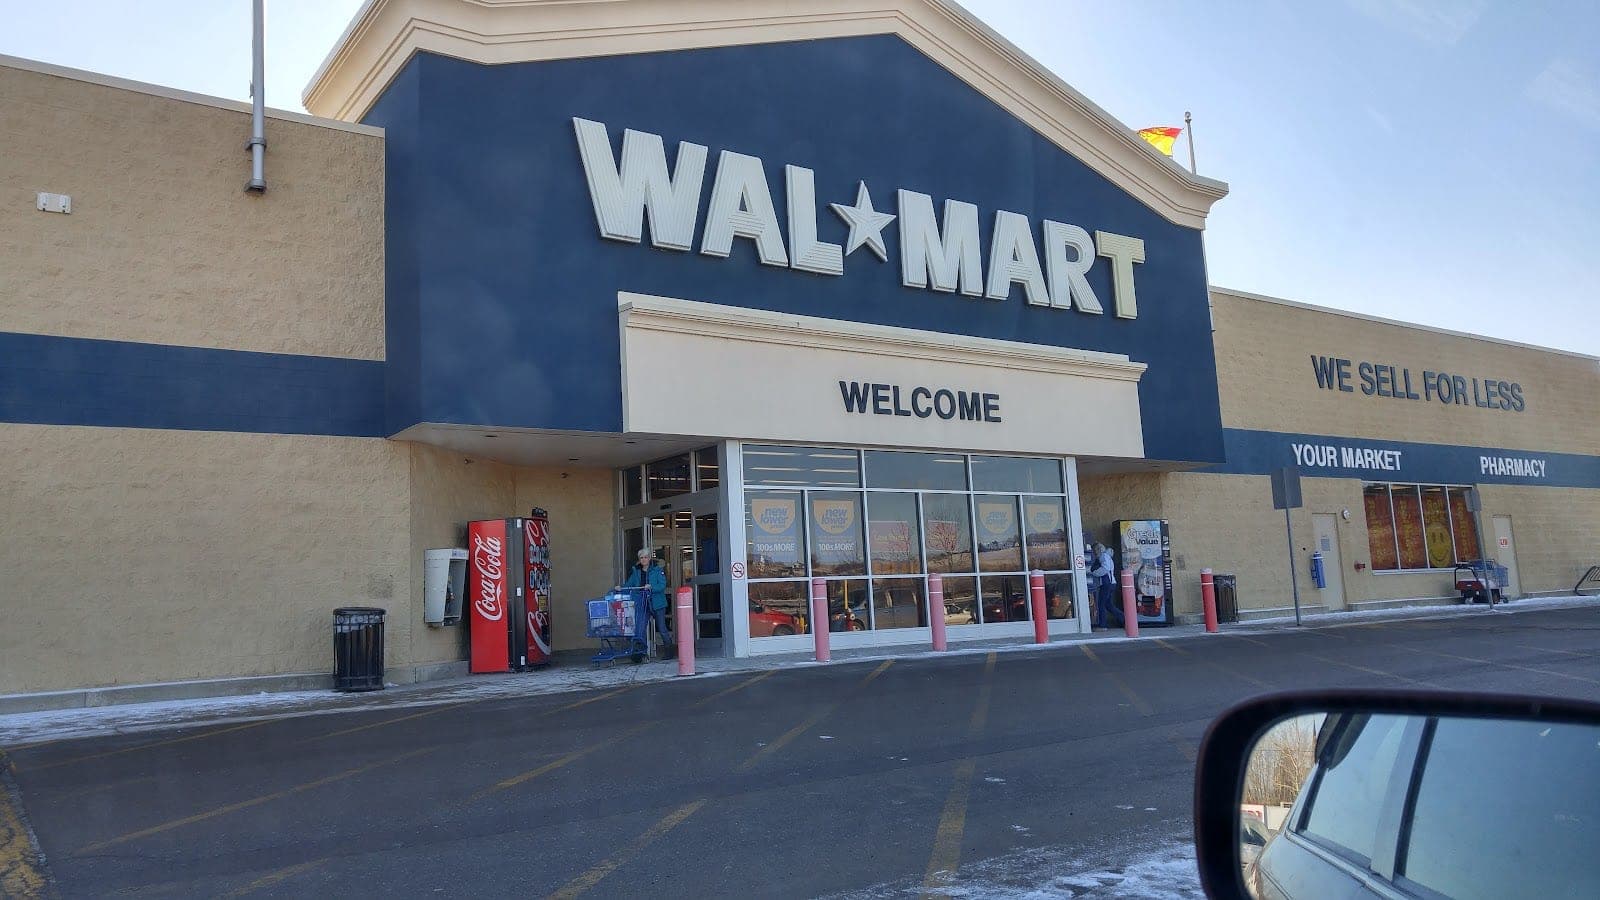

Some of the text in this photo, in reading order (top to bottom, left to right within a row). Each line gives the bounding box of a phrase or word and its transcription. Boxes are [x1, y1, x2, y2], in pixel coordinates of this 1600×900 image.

[1310, 354, 1526, 412] WE SELL FOR LESS
[839, 380, 1002, 423] WELCOME
[1291, 443, 1402, 471] YOUR MARKET
[1480, 455, 1547, 478] PHARMACY
[826, 507, 848, 517] new
